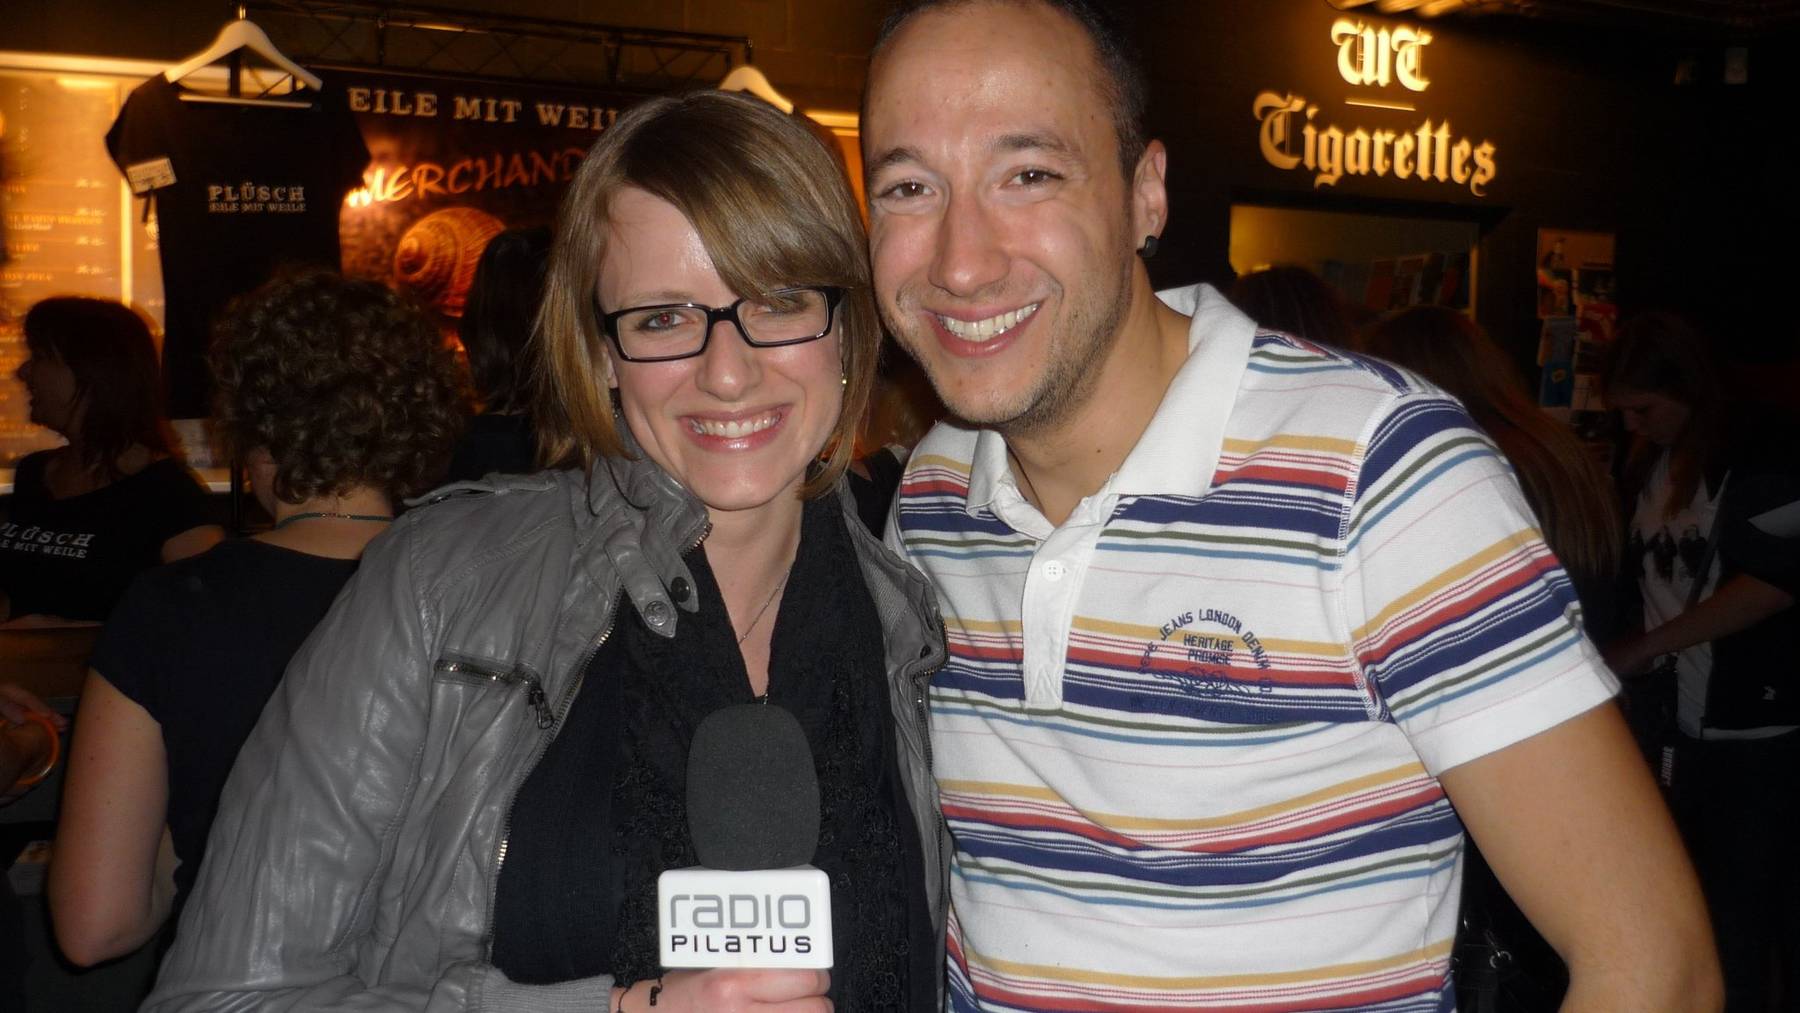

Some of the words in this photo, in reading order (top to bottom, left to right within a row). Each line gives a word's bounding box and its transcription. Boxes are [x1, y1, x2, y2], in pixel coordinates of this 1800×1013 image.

[347, 87, 438, 117] EILE
[453, 95, 523, 123] MIT
[1253, 90, 1497, 197] Cigarettes
[208, 182, 305, 202] PLÜSCH
[241, 202, 265, 213] MIT
[13, 541, 39, 552] MIT
[43, 544, 88, 559] WEILE
[1159, 611, 1194, 641] JEANS
[1199, 608, 1243, 634] LONDON
[1183, 633, 1234, 652] HERITAGE
